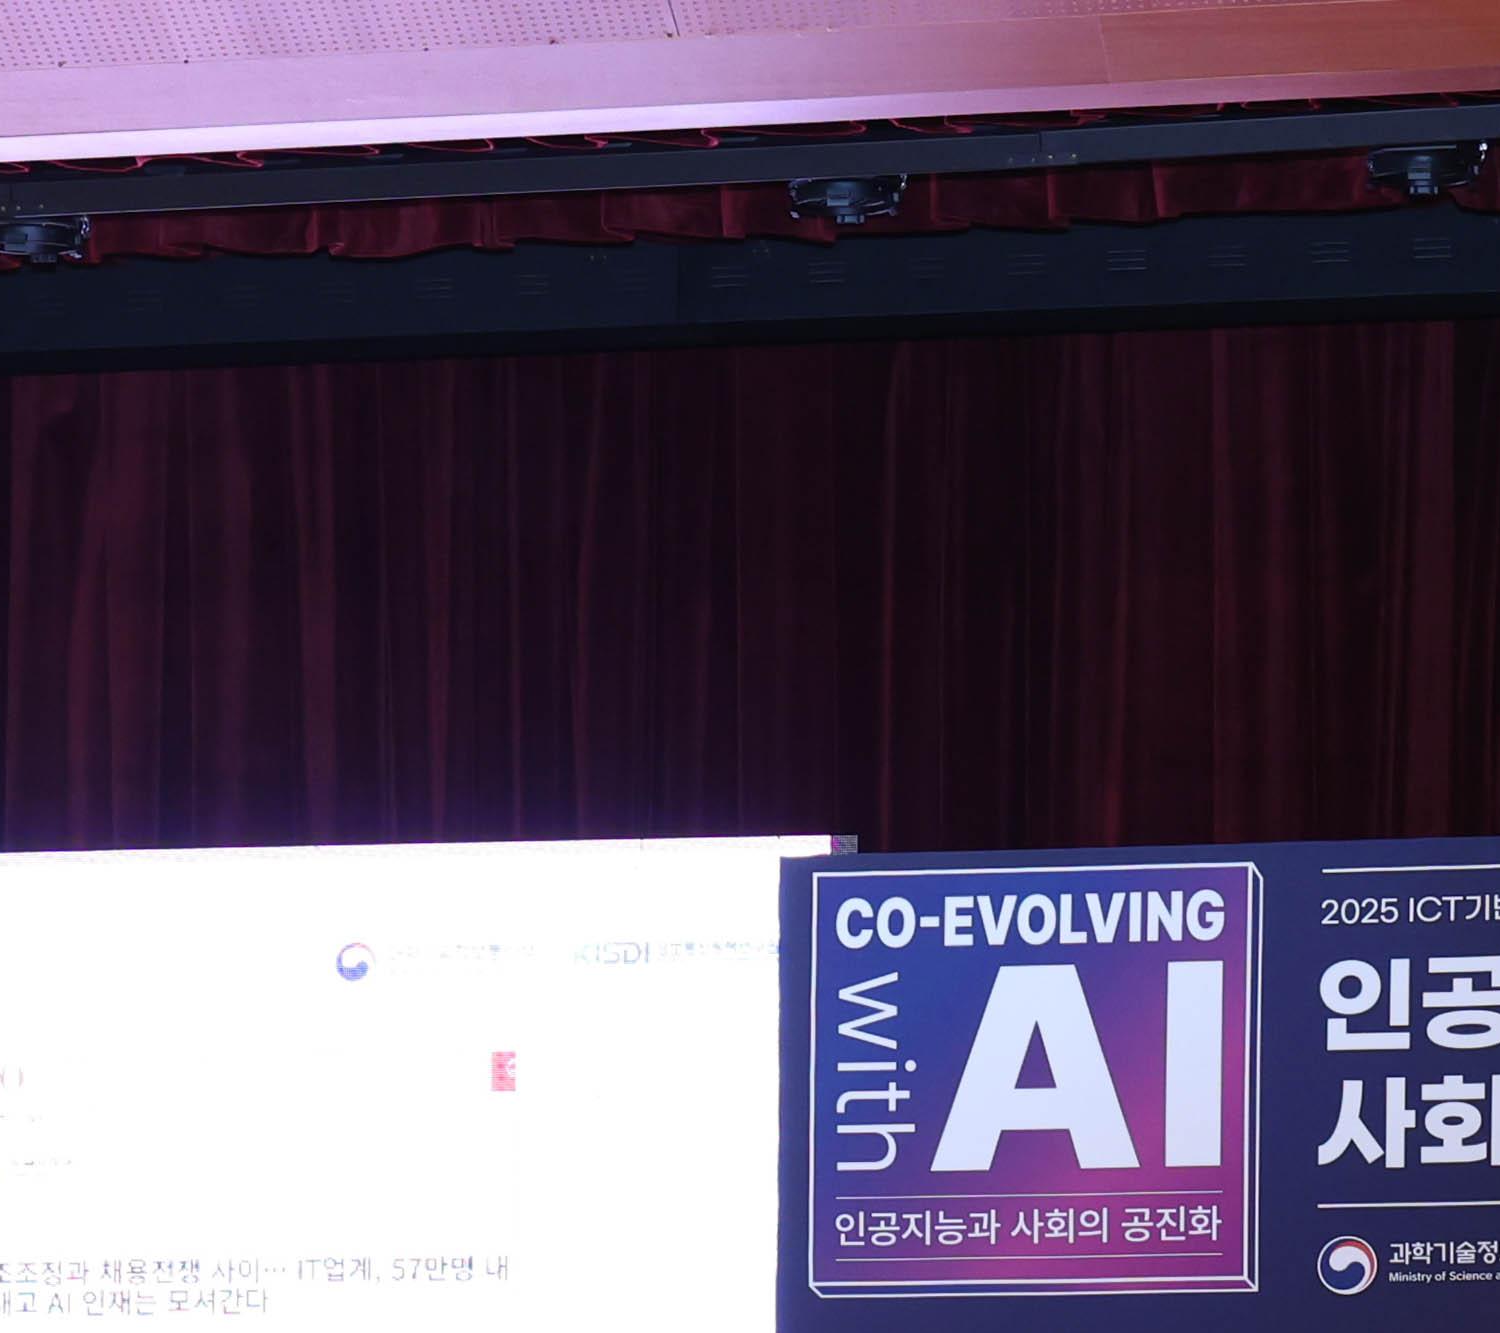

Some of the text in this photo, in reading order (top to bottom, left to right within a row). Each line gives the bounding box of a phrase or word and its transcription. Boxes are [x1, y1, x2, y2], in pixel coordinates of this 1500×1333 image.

[834, 889, 1225, 949] CO-EVOLVING
[1320, 897, 1399, 925] 2025
[834, 971, 917, 1174] with
[930, 959, 1224, 1174] AI
[833, 1205, 1222, 1247] 인공지능과 사회의 공진화
[99, 1258, 201, 1284] 채용전쟁
[391, 1255, 475, 1282] 57만명
[486, 1254, 510, 1281] 내
[1389, 1272, 1432, 1283] Ministry
[1434, 1271, 1446, 1281] of
[1449, 1270, 1493, 1281] Science
[48, 1293, 71, 1314] AI
[81, 1289, 157, 1316] 인재는
[167, 1288, 270, 1315] 모셔간다
